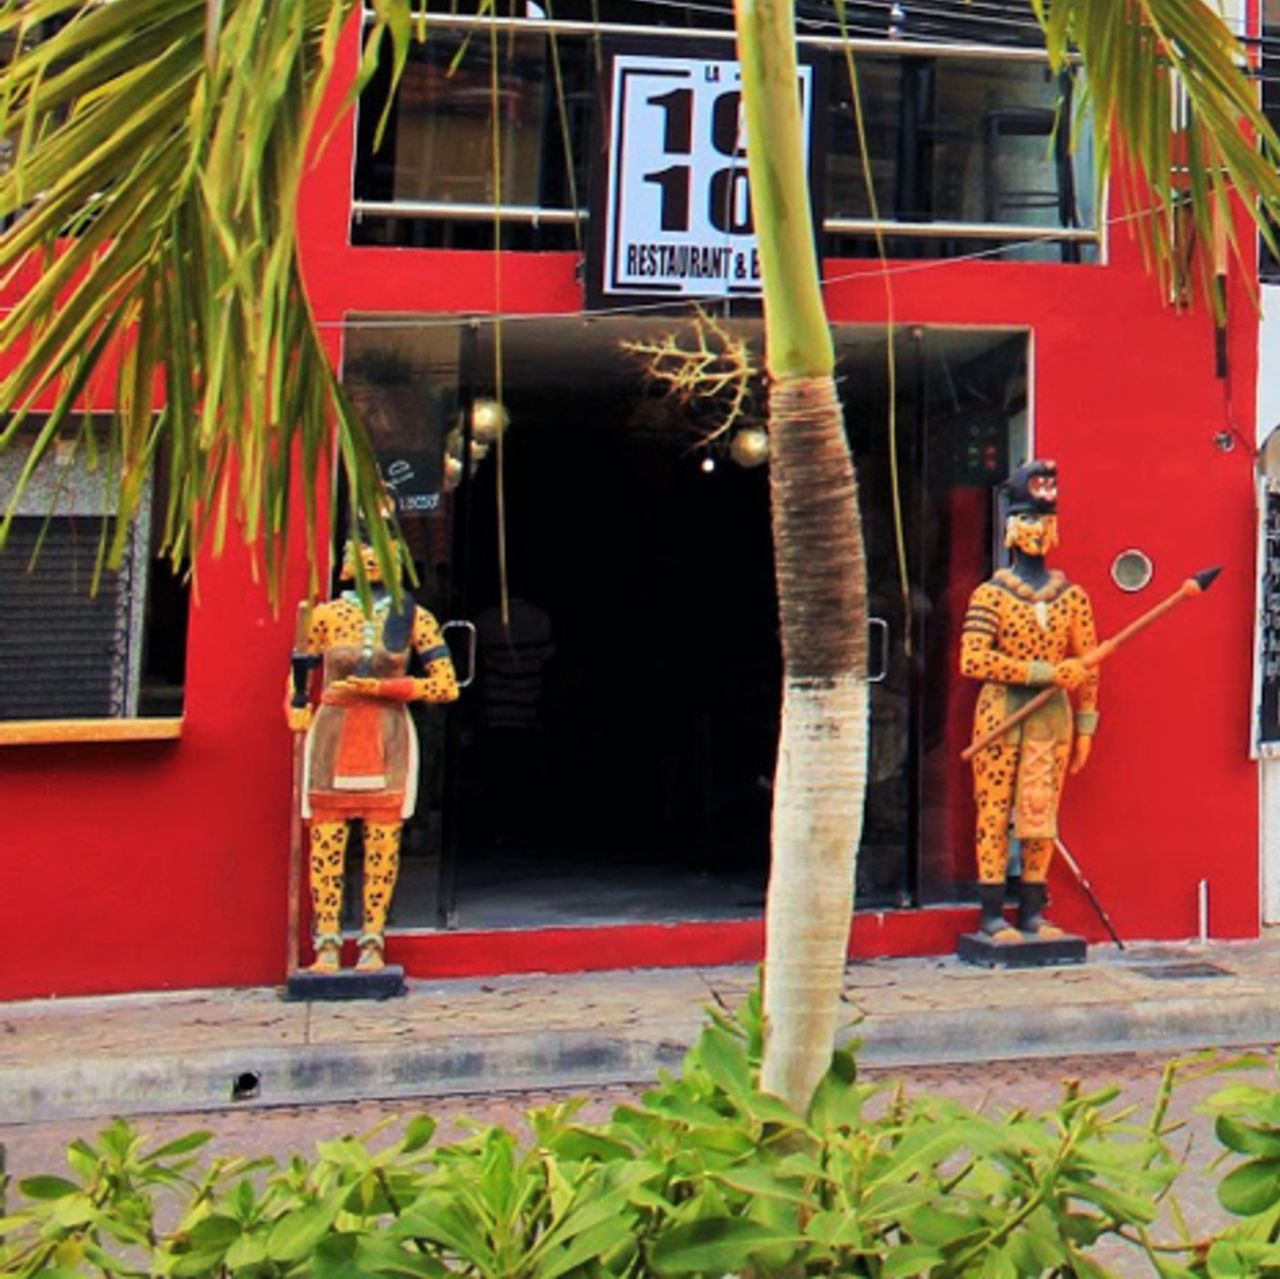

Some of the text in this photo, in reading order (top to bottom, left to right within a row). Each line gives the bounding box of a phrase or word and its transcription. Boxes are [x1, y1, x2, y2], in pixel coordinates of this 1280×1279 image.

[704, 65, 720, 82] LA
[627, 244, 732, 279] RESTAURANT
[735, 252, 746, 279] &
